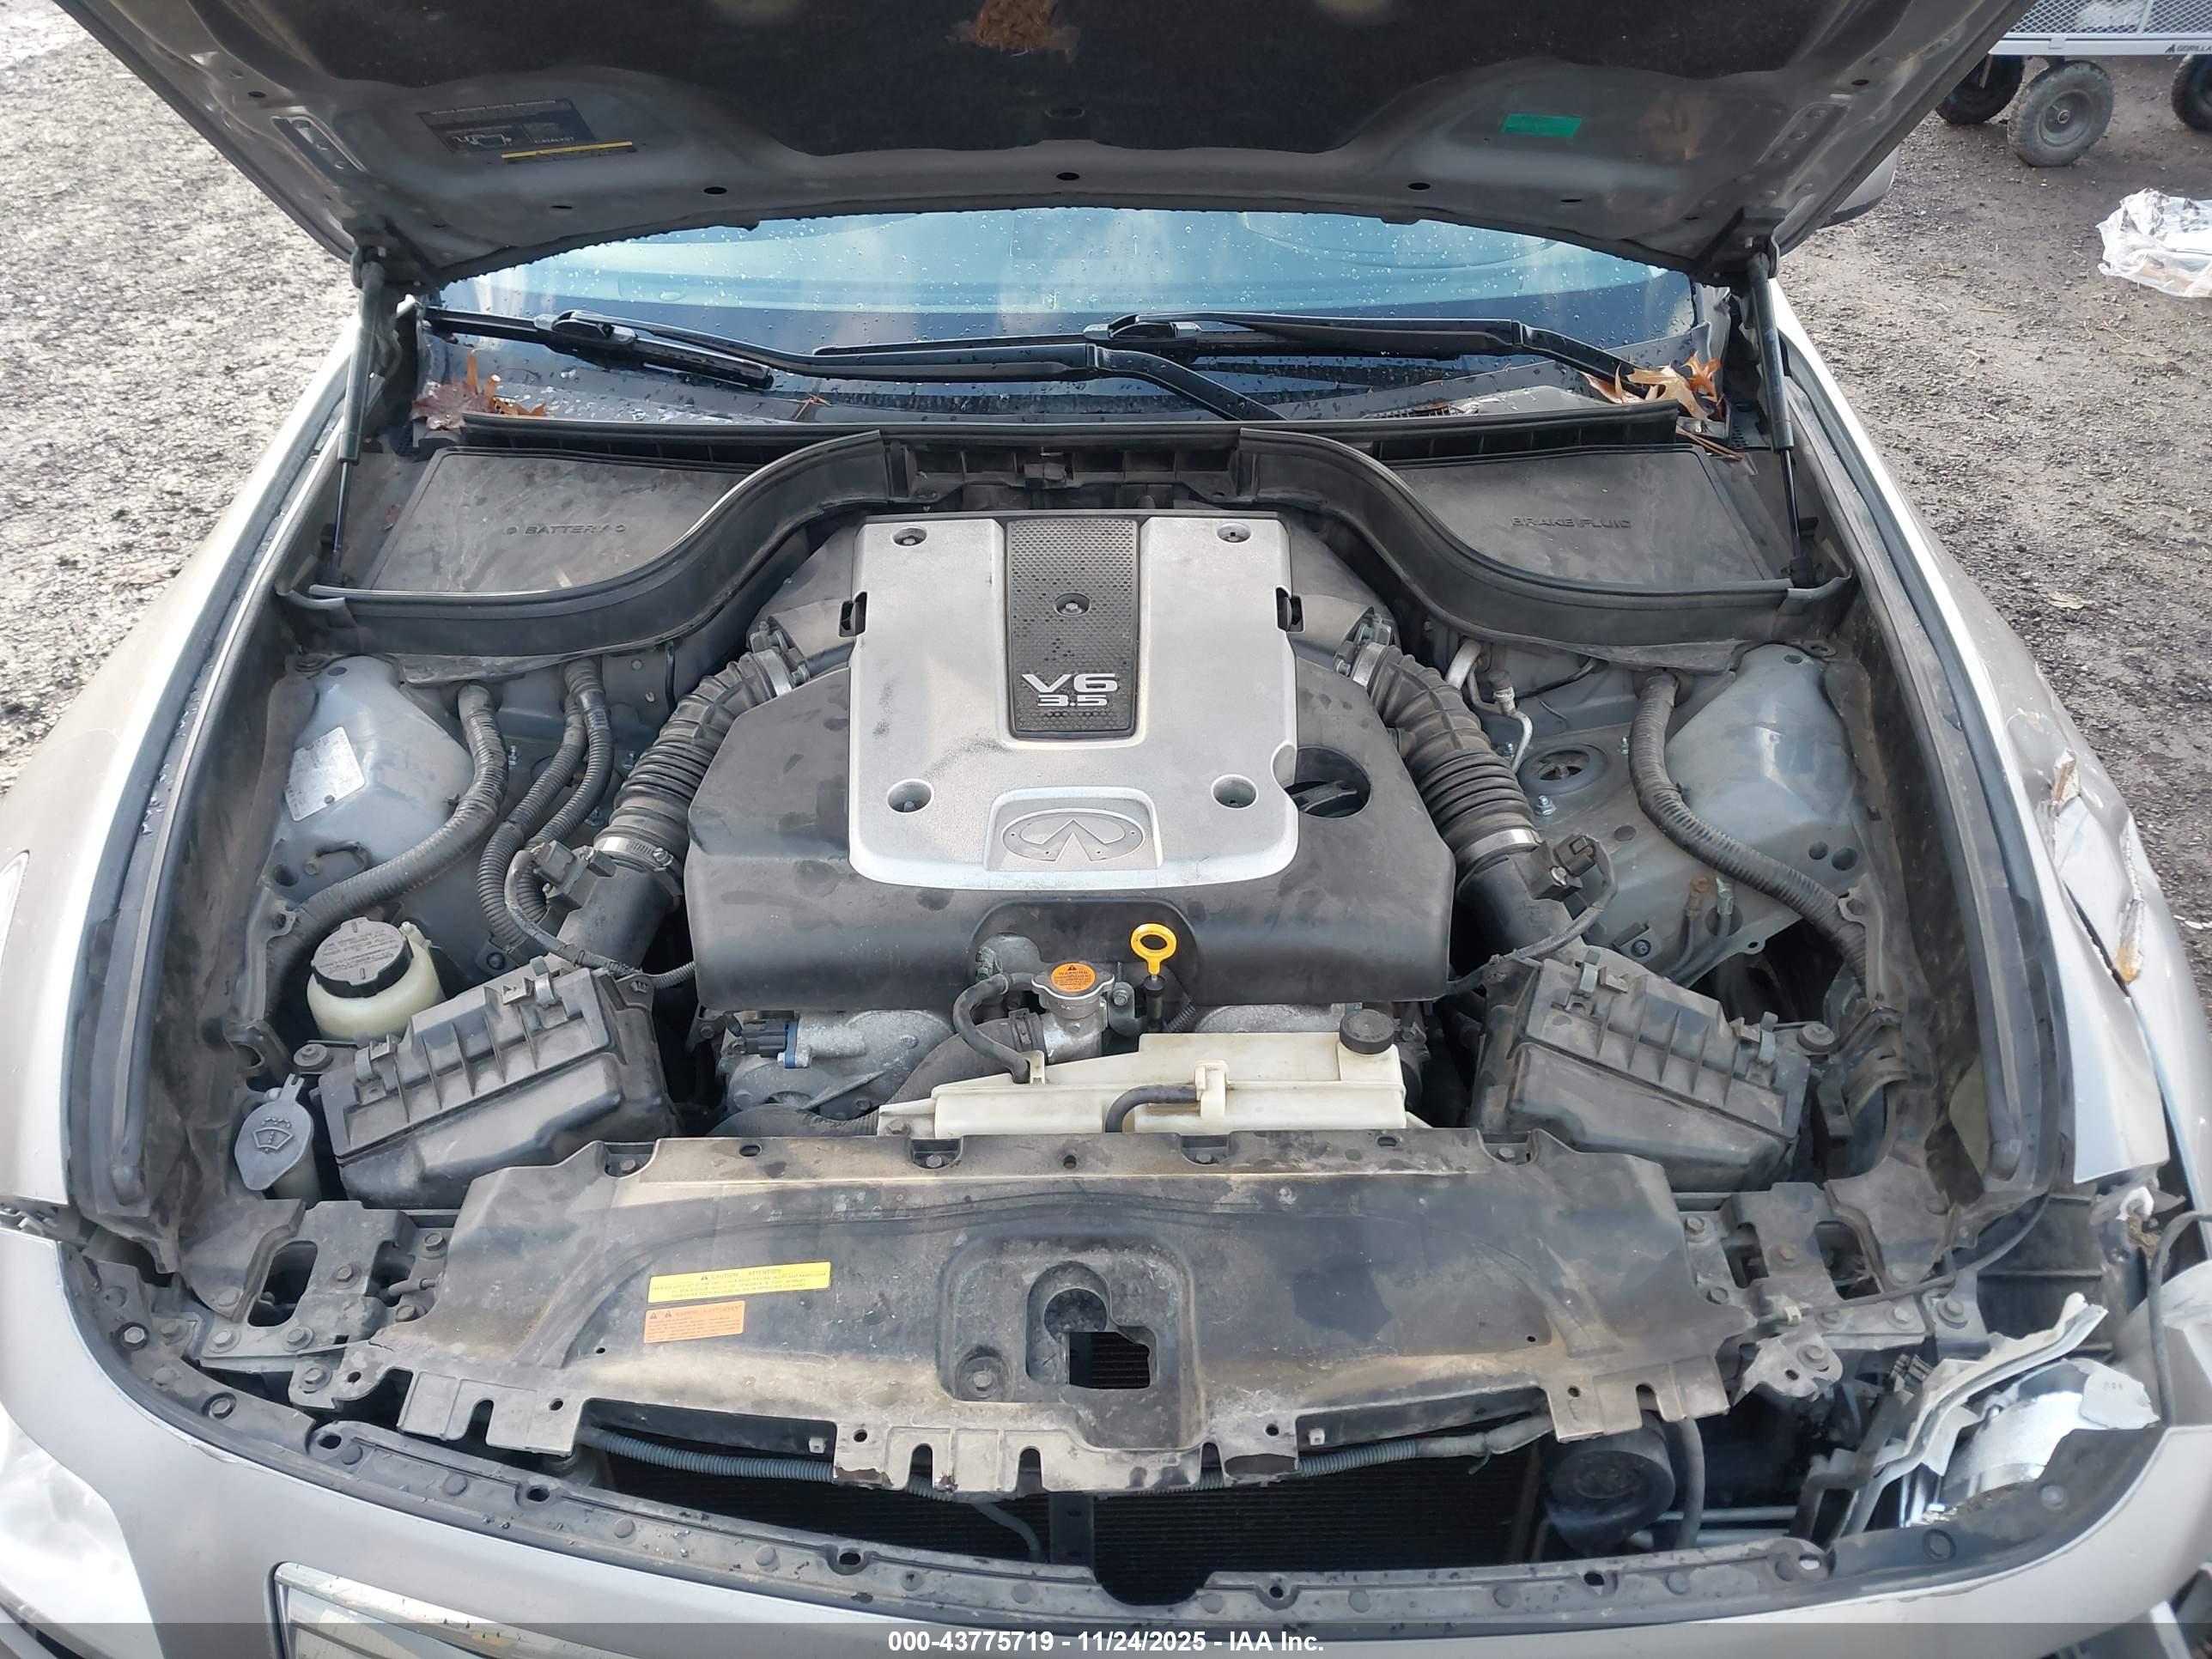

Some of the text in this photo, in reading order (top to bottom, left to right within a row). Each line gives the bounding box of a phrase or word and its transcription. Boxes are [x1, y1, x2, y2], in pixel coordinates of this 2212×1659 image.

[1511, 517, 1632, 528] BRAKE FLUID
[1021, 672, 1118, 693] V6
[1037, 694, 1108, 707] 3.5
